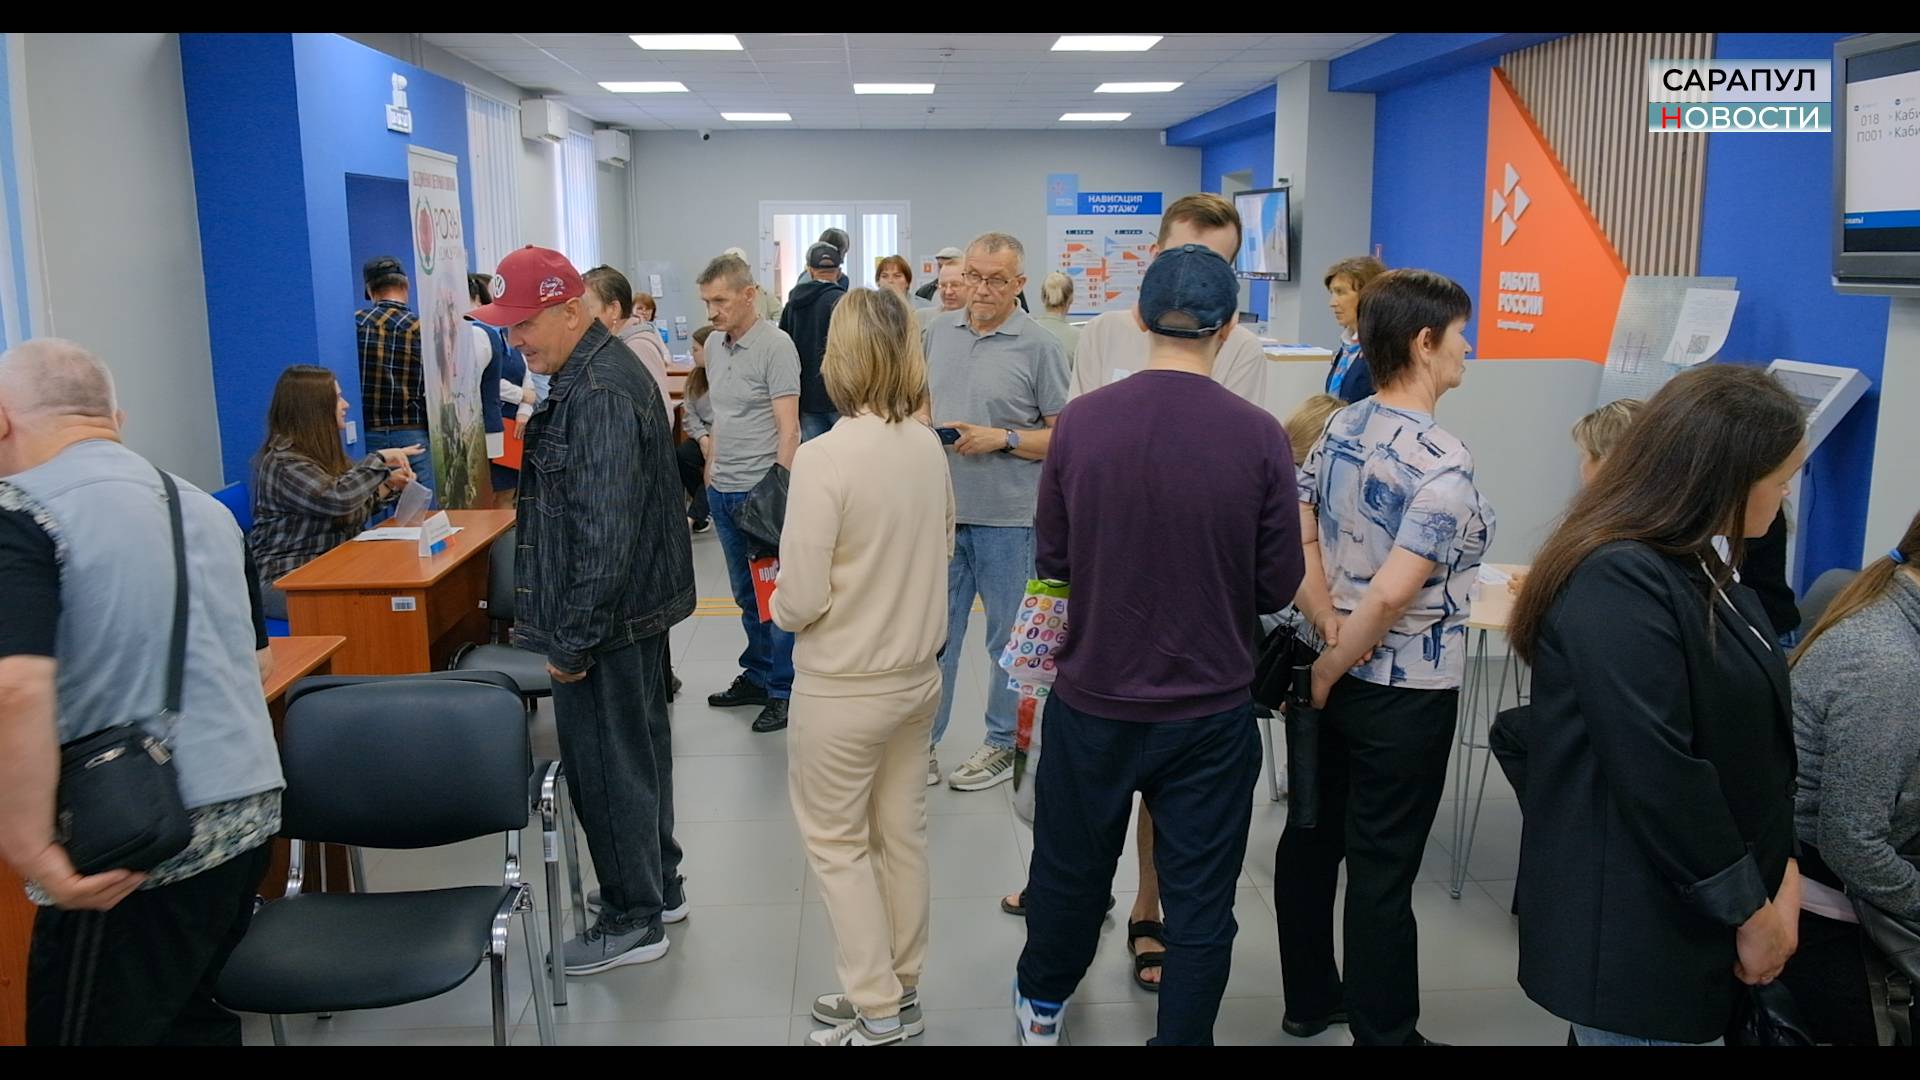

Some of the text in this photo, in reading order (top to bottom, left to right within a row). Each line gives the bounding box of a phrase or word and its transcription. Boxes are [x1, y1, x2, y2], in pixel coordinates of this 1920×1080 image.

[1860, 113, 1880, 127] 018
[1856, 129, 1882, 143] П001
[1088, 194, 1143, 204] НАВИГАЦИЯ
[1092, 205, 1138, 213] ПО ЭТАЖУ
[1499, 271, 1541, 292] РАБОТА
[1498, 293, 1544, 316] РОССИИ
